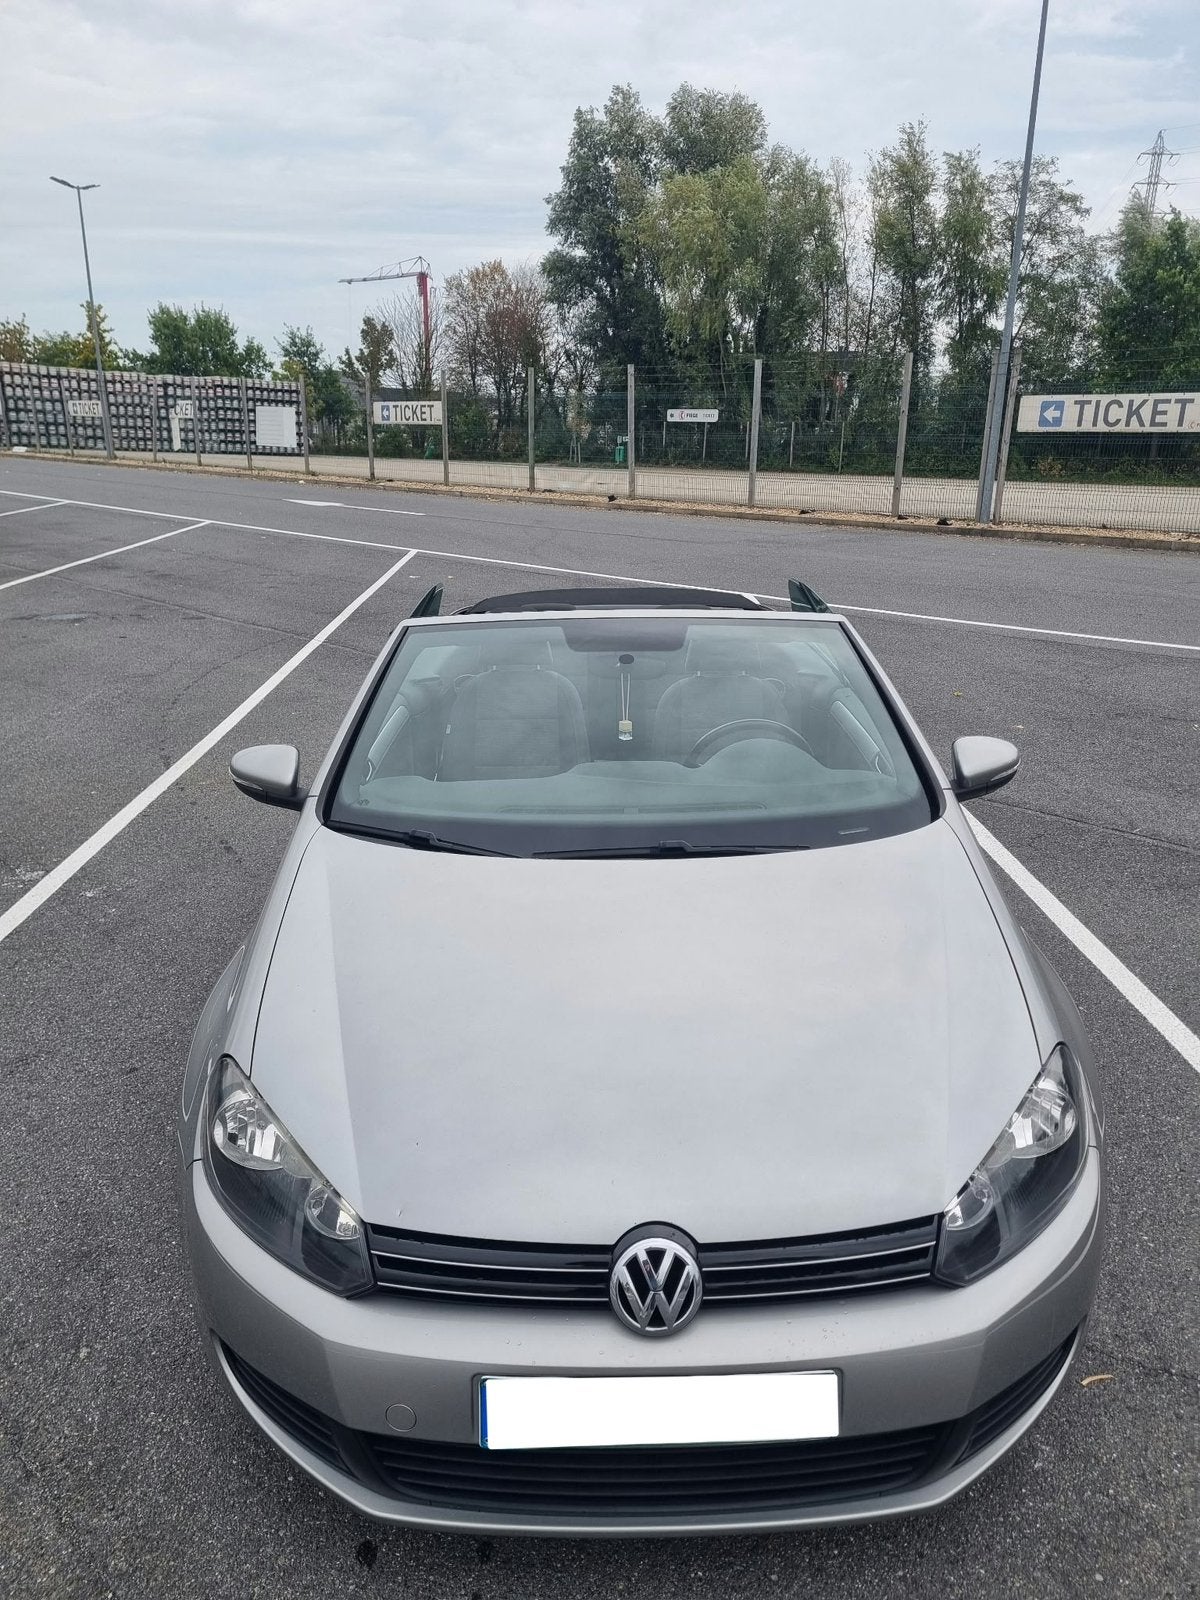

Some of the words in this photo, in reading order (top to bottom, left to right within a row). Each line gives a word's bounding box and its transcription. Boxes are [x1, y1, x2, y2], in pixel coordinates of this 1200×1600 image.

[78, 402, 100, 415] TICKET
[392, 404, 435, 421] TICKET
[1073, 398, 1196, 428] TICKET
